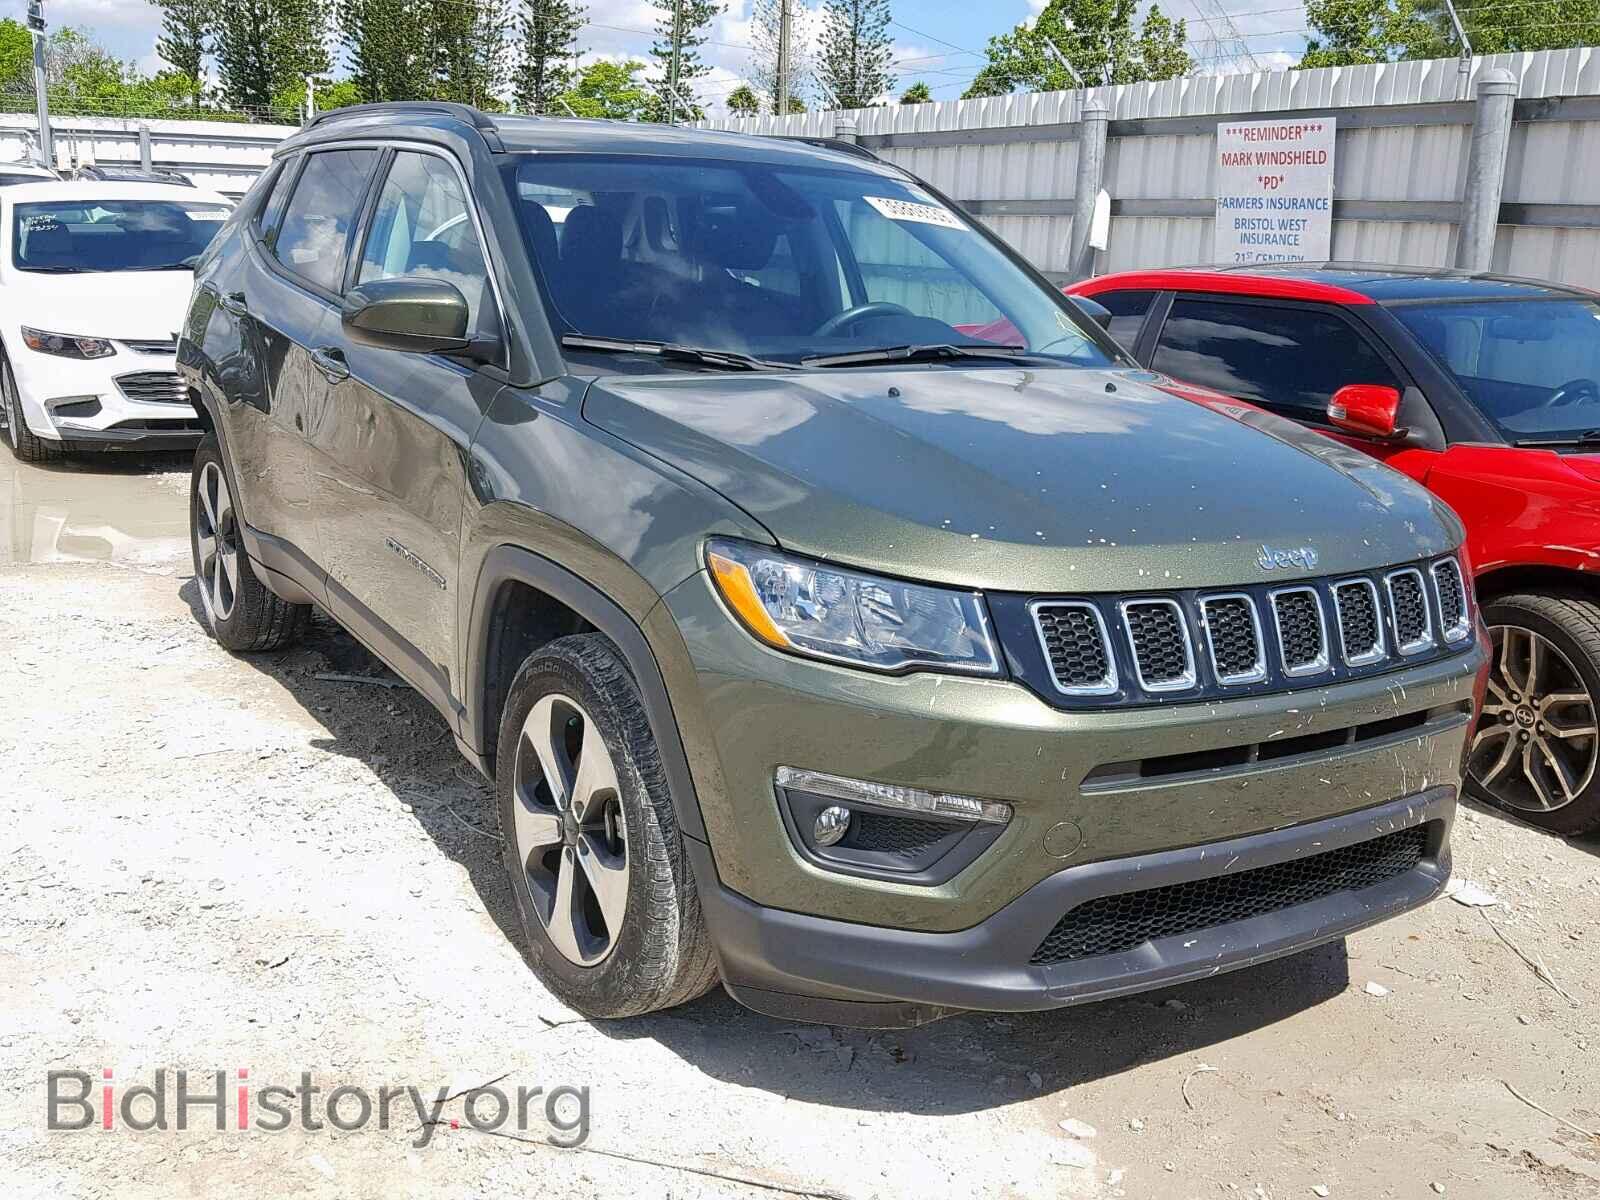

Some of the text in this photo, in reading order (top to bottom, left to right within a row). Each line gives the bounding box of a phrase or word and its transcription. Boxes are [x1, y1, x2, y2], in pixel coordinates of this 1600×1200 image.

[1221, 150, 1327, 166] MARK WINDSHIELD
[1218, 197, 1329, 210] FARMERS INSURANCE
[1234, 218, 1308, 231] BRISTOL WEST
[1240, 232, 1300, 246] INSURANCE
[1257, 543, 1318, 572] Jeep
